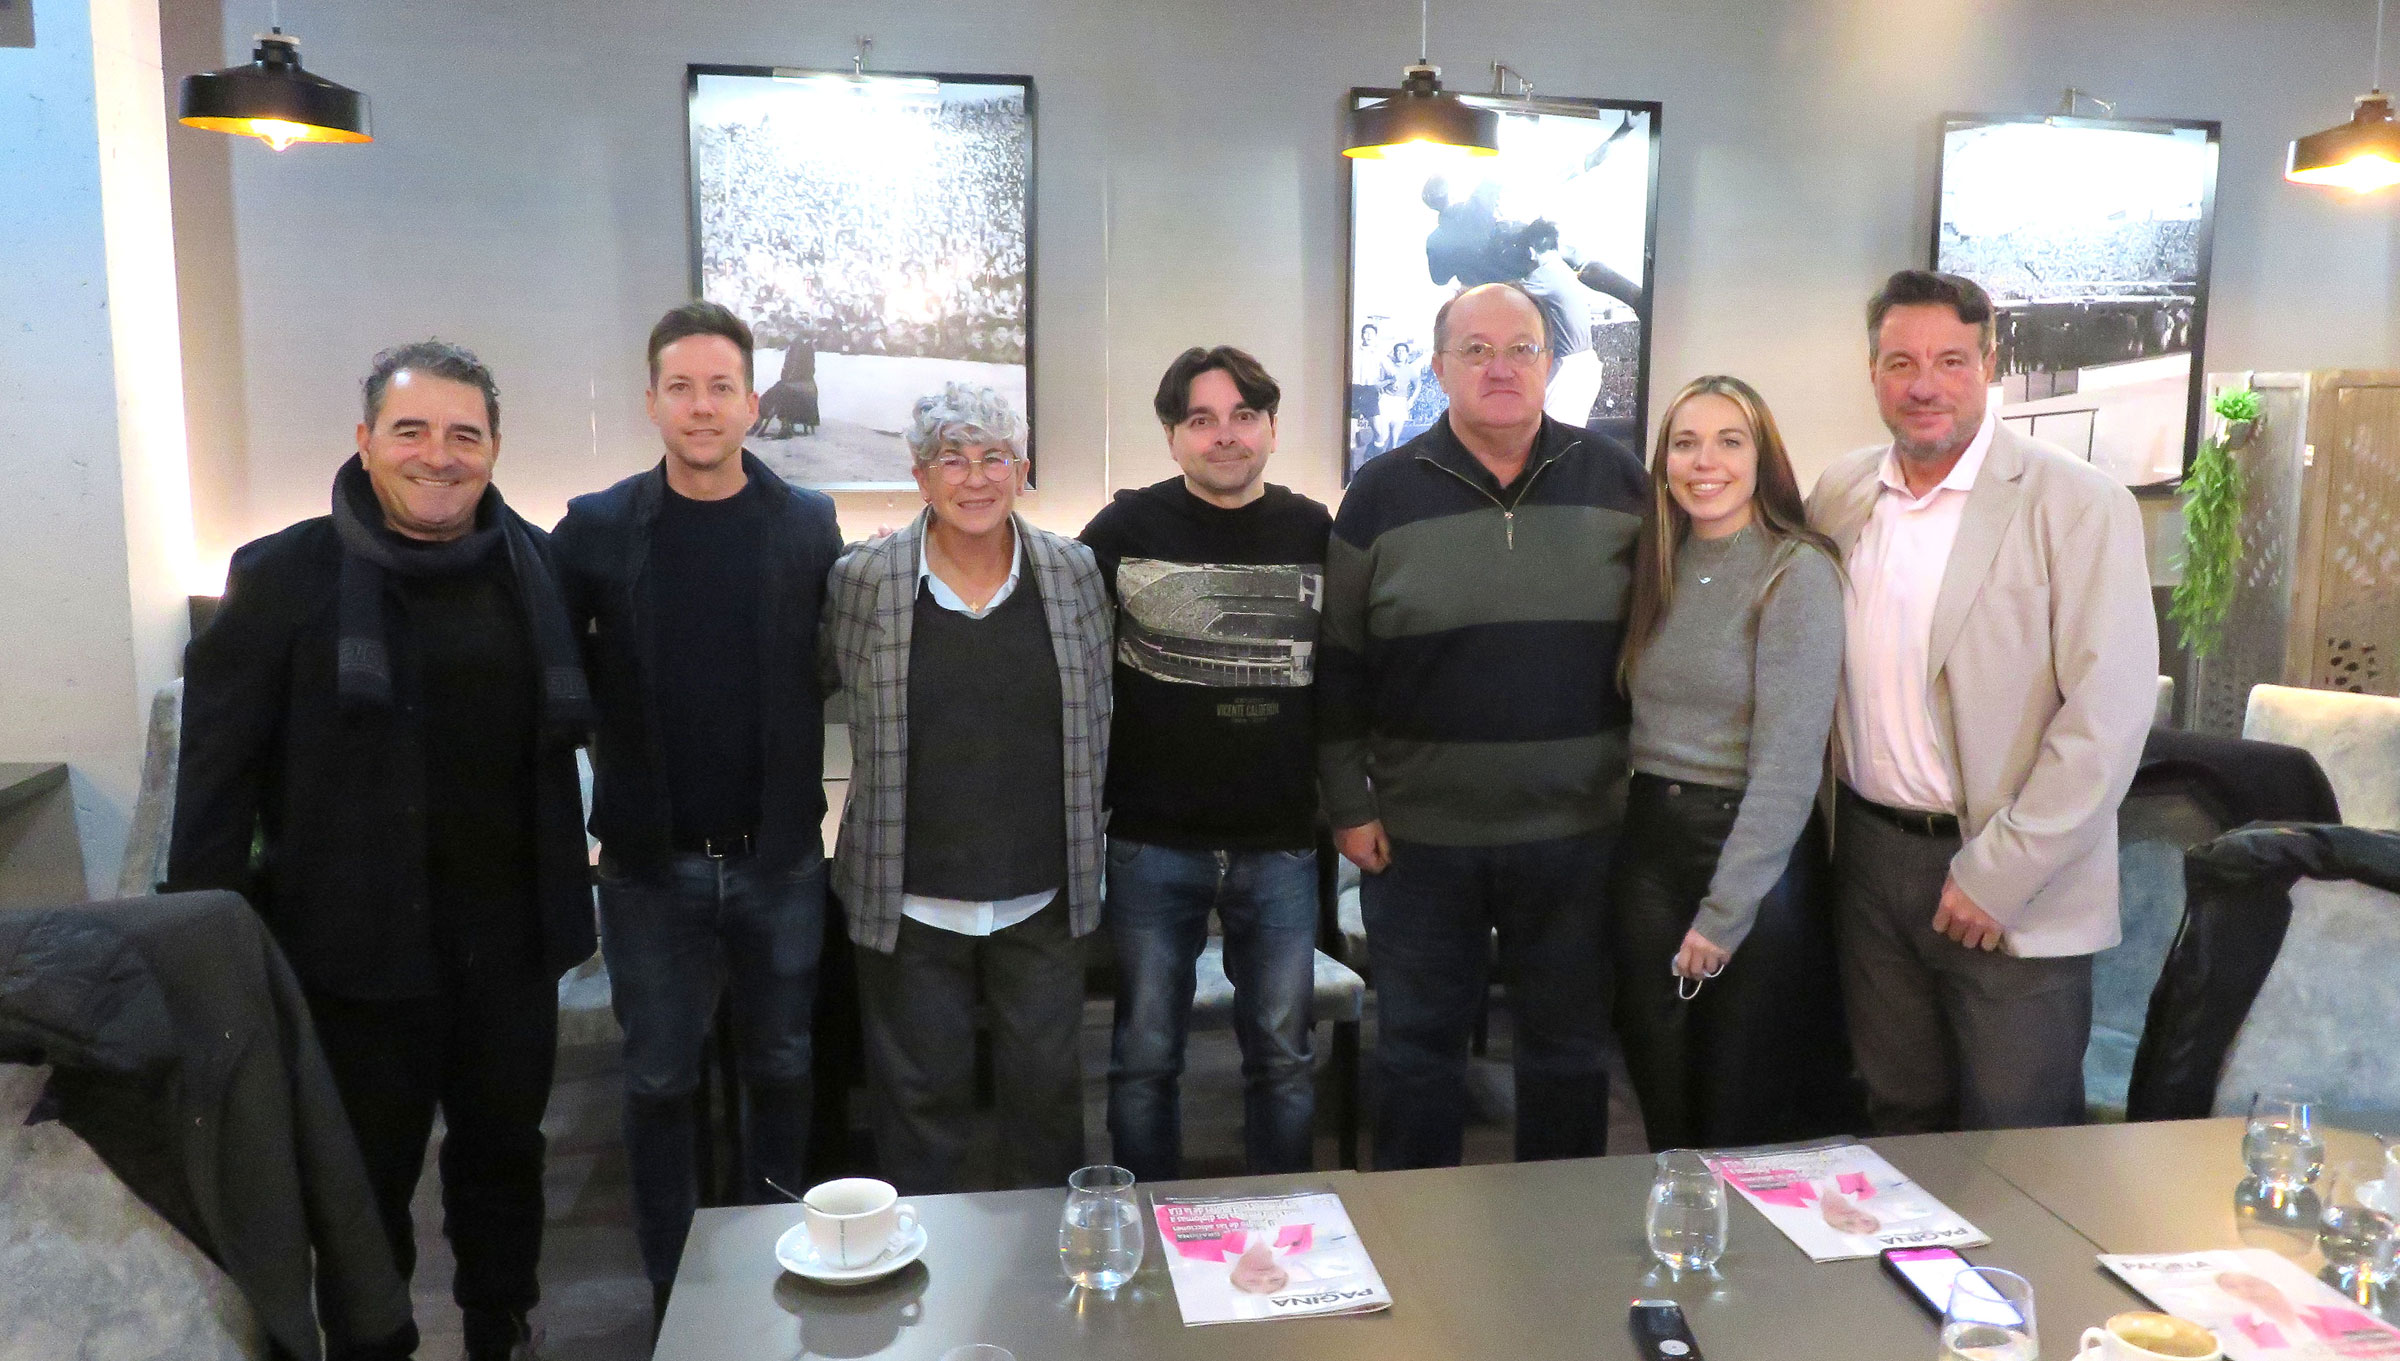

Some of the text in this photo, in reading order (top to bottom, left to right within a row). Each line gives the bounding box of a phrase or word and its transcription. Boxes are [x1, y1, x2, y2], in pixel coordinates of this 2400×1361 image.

[1217, 703, 1245, 716] VICENTE
[1168, 1208, 1183, 1216] ELA
[1177, 1214, 1215, 1223] diplomas
